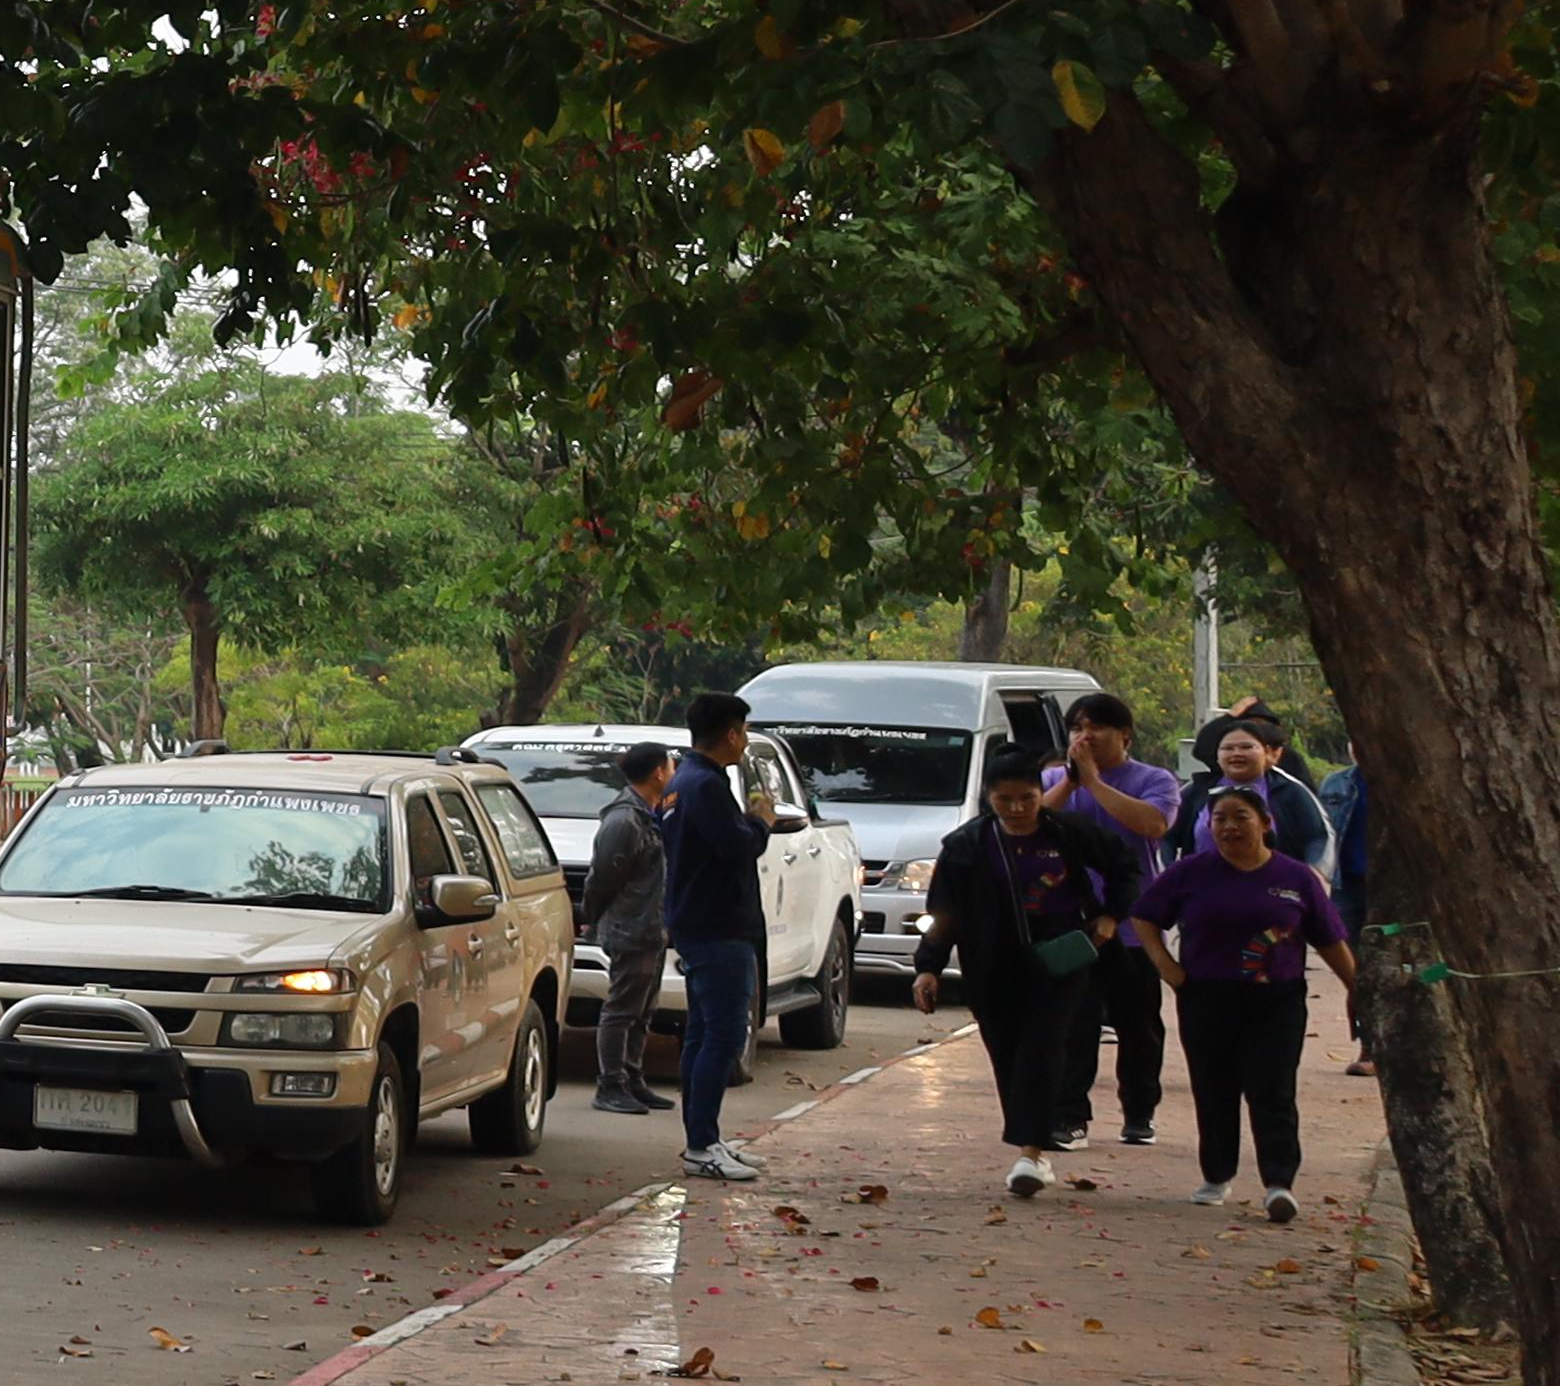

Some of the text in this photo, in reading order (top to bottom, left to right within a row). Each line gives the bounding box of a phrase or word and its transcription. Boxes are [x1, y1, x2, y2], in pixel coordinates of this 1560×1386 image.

[66, 786, 361, 816] มหาวิทยาลัยราชภัฏกำแพงเพชร
